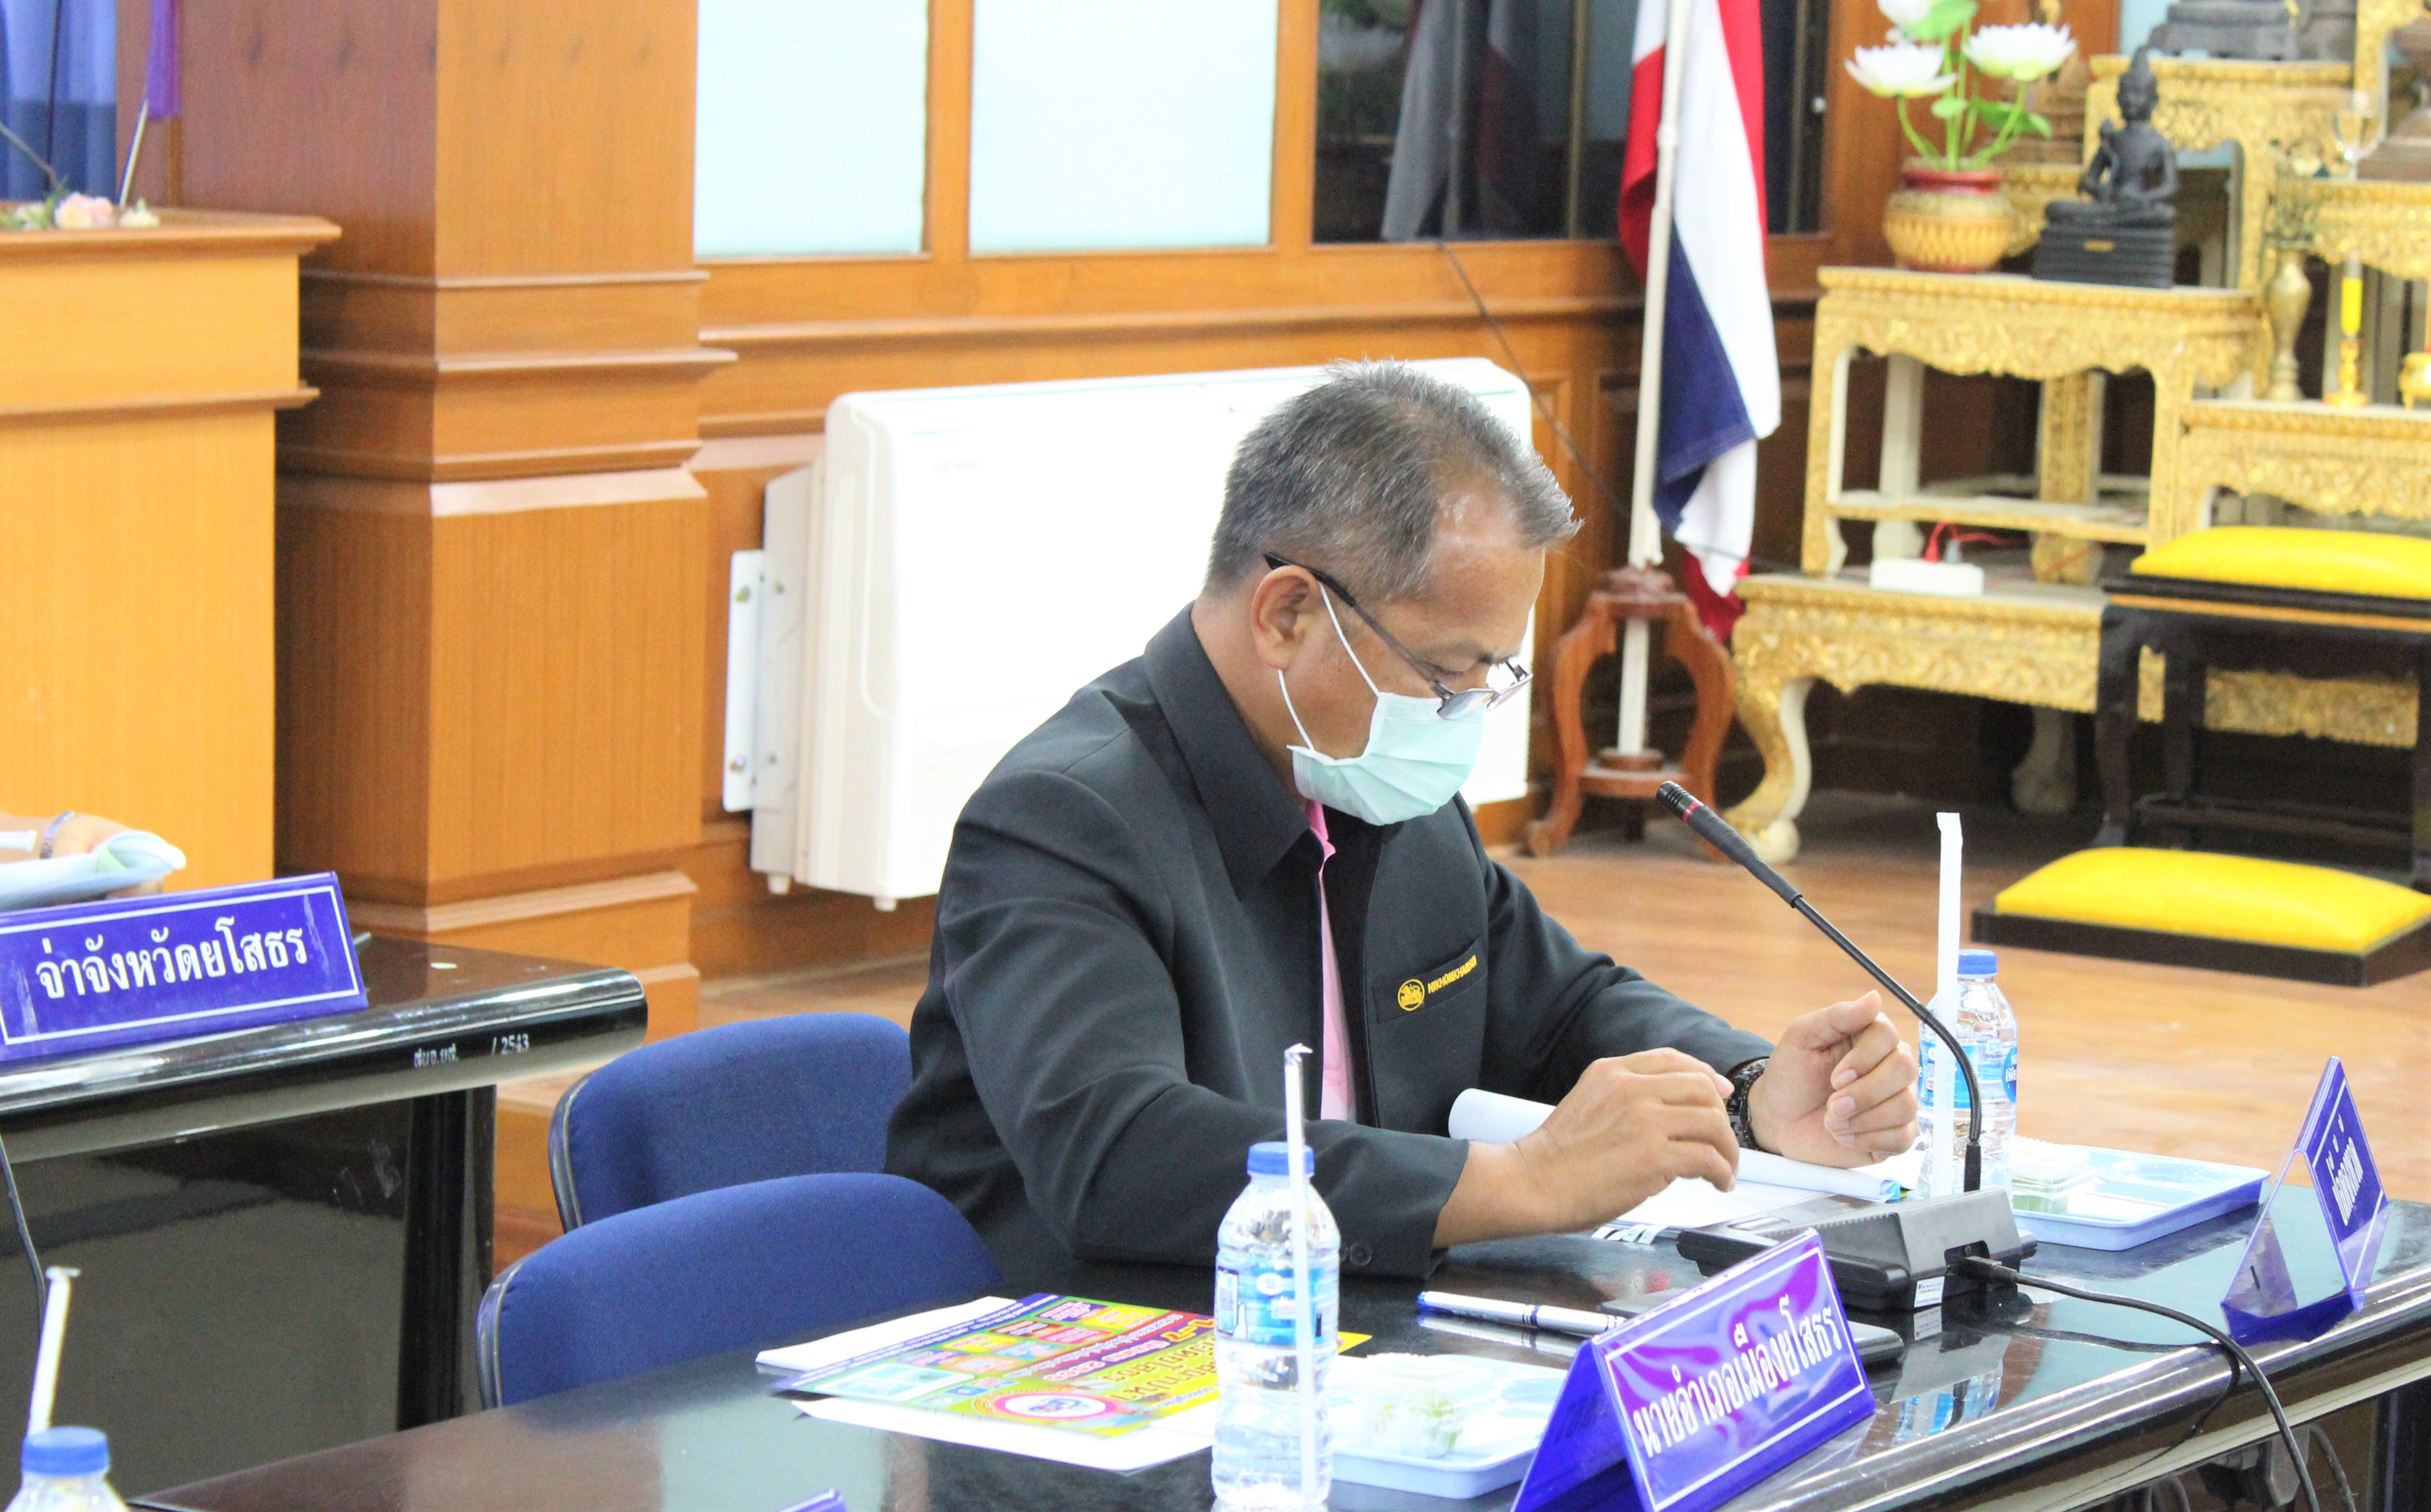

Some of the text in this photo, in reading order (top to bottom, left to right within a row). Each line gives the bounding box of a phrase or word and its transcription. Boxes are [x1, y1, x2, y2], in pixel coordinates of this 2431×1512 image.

[36, 916, 308, 999] จ่าจังหวัดยโสธร
[1633, 1293, 1843, 1459] นายอำเภอเมืองยโสธร
